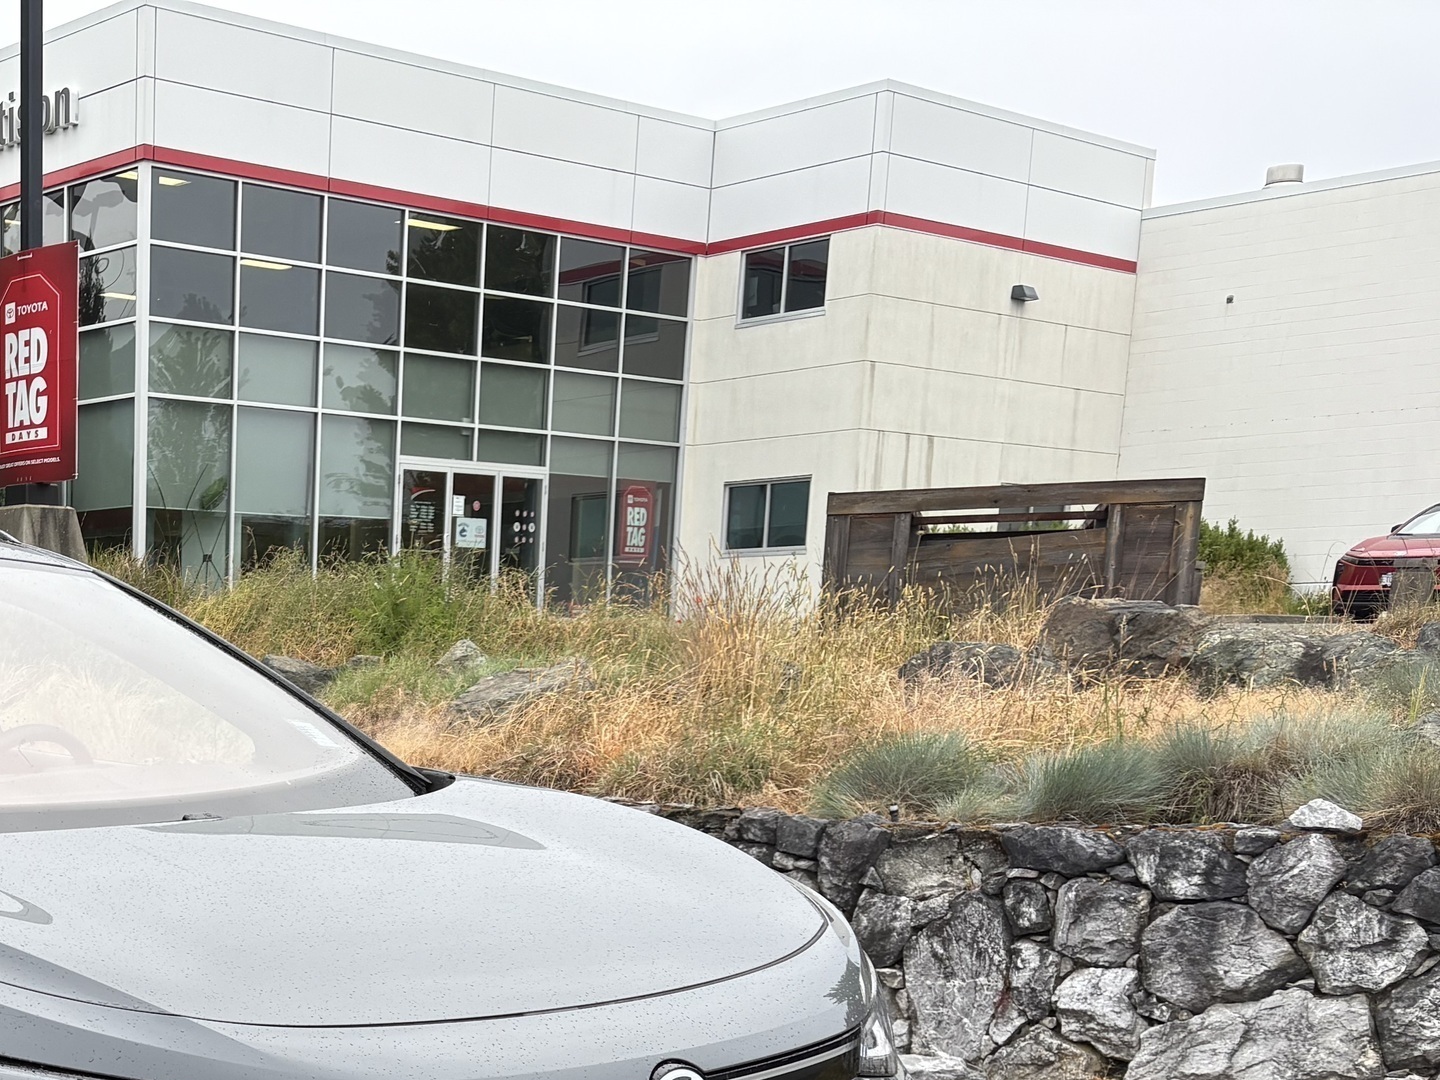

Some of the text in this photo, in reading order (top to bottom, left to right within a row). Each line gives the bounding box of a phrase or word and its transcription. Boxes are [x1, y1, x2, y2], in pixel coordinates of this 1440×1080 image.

[17, 301, 49, 316] TOYOTA
[4, 326, 48, 380] RED
[4, 376, 48, 429] TAG
[11, 429, 40, 442] DAYS
[626, 506, 648, 527] RED
[626, 526, 646, 547] TAG
